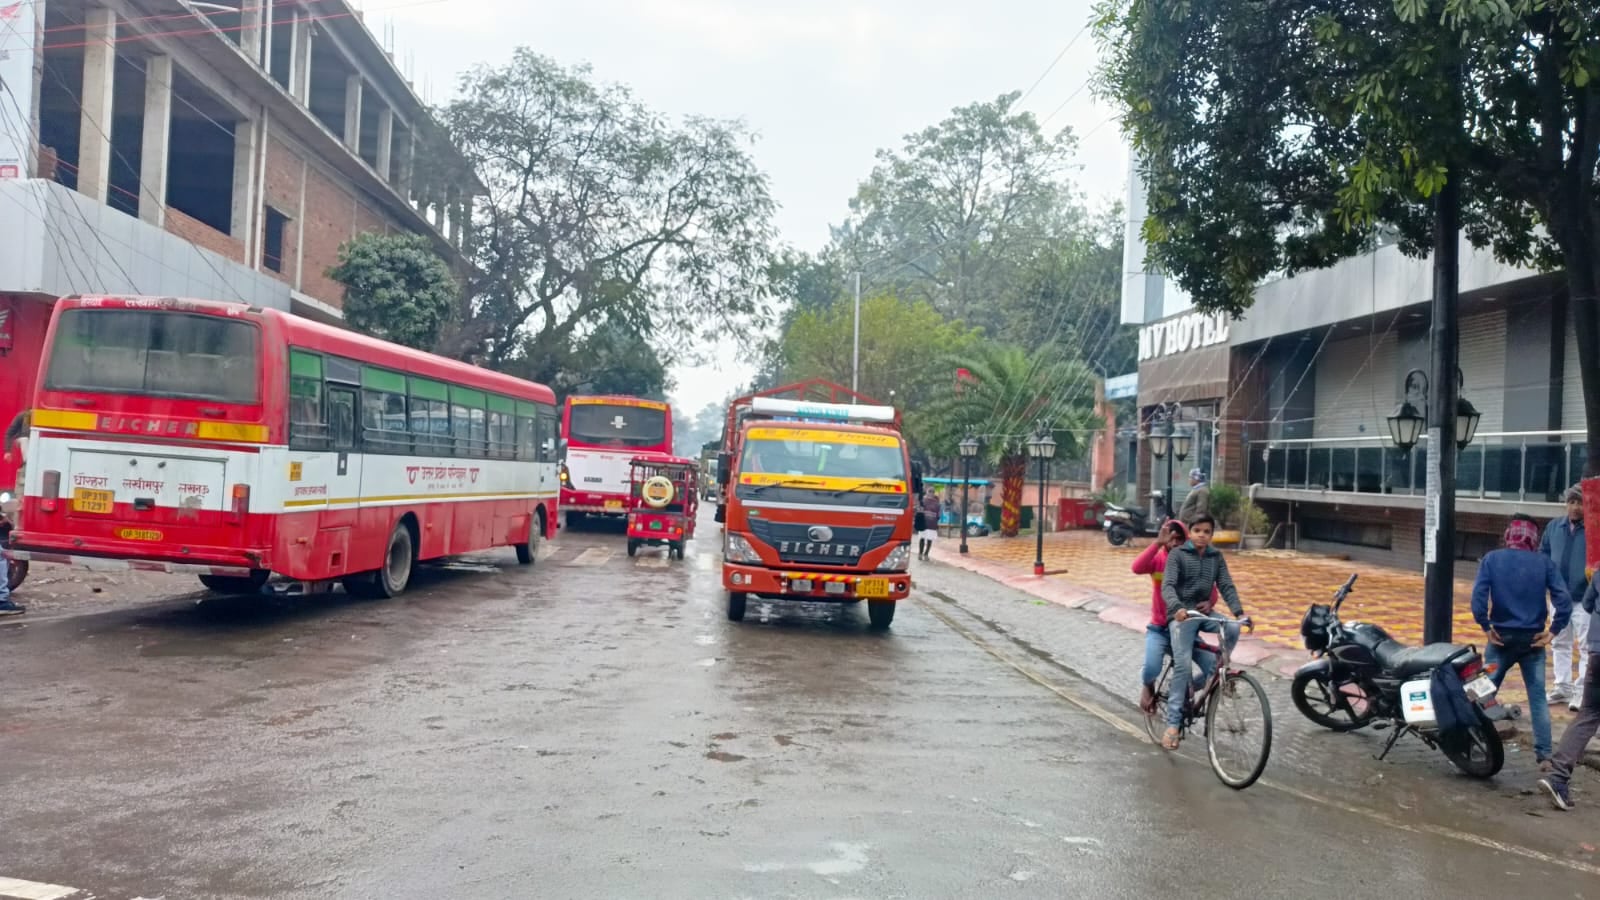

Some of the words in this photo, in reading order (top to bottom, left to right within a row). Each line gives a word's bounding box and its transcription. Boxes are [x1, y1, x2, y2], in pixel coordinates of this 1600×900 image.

[101, 416, 198, 434] EICHER
[122, 477, 164, 494] लखीमपुर
[178, 482, 209, 495] लखनऊ
[780, 541, 860, 556] EICHER
